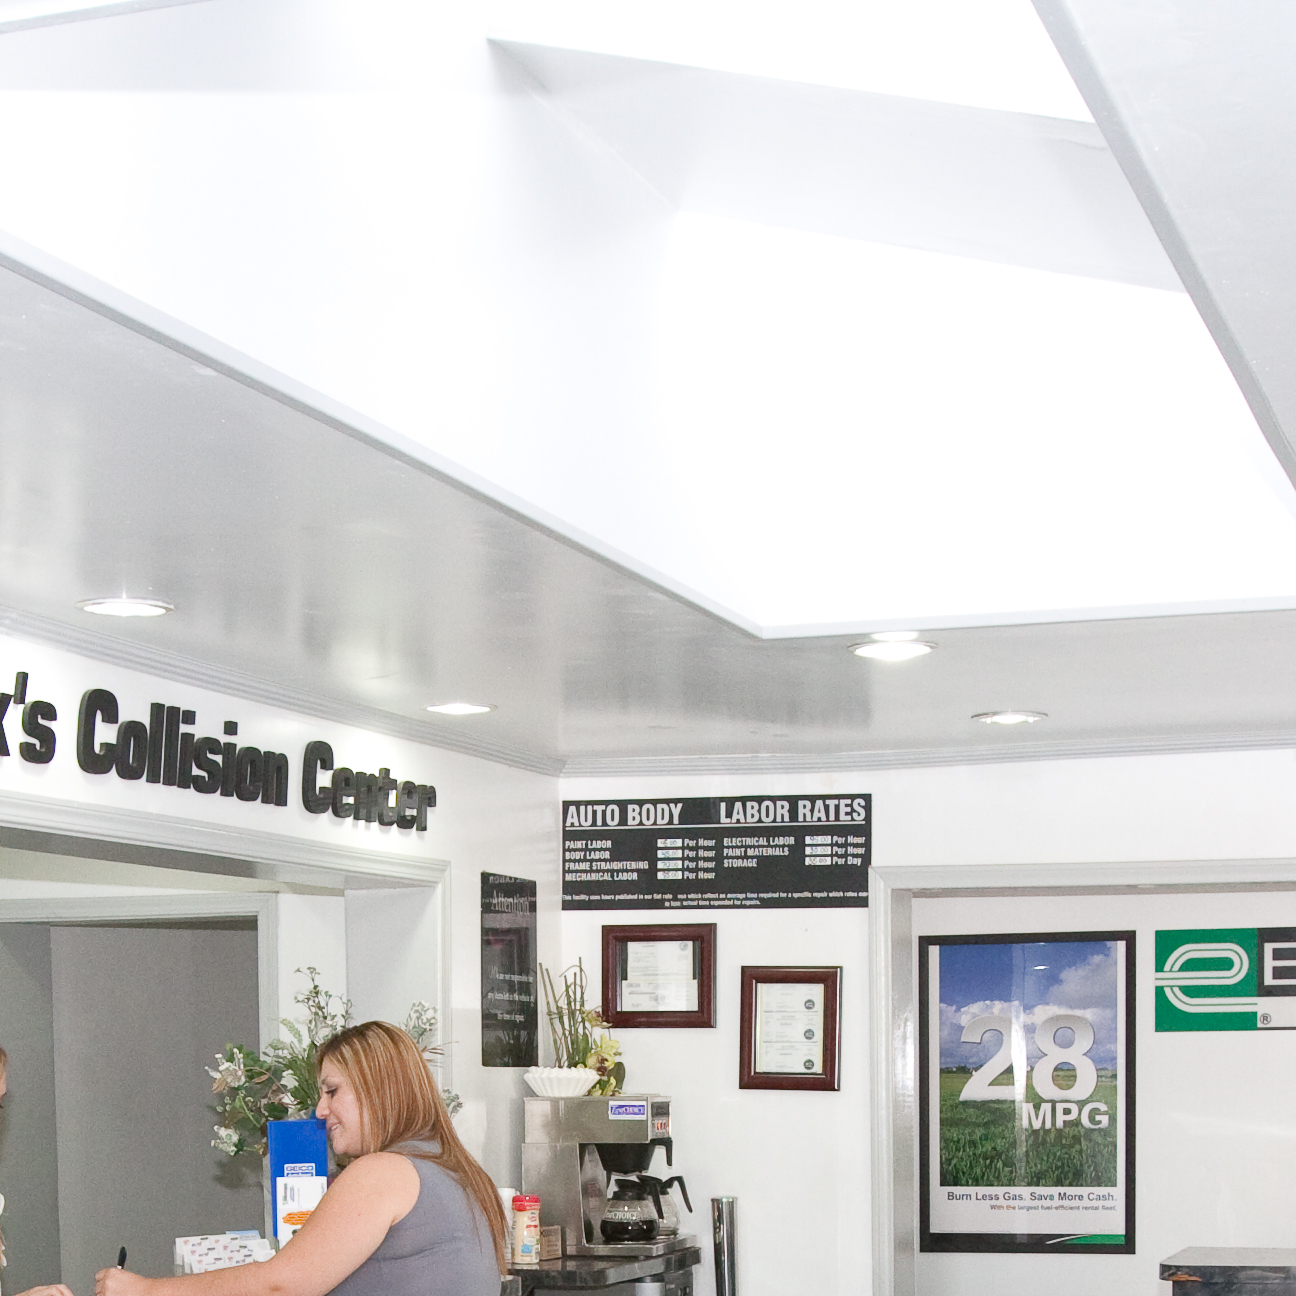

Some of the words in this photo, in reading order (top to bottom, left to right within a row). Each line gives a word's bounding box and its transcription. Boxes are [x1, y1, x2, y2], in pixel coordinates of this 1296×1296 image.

[76, 687, 289, 808] Collision
[301, 739, 438, 833] Center
[565, 803, 620, 827] AUTO
[627, 802, 683, 826] BODY
[719, 800, 790, 824] LABOR
[797, 798, 866, 822] RATES
[565, 840, 587, 849] PAINT
[588, 840, 612, 849] LABOR
[684, 838, 696, 847] Per
[698, 838, 716, 847] Hour
[723, 837, 768, 846] ELECTRICAL
[769, 836, 795, 845] LABOR
[833, 835, 846, 844] Per
[847, 835, 866, 844] Hour
[565, 851, 585, 860] BODY
[586, 850, 610, 859] LABOR
[684, 849, 696, 858] Per
[698, 849, 716, 858] Hour
[723, 848, 746, 857] PAINT
[747, 847, 789, 856] MATERIALS
[833, 846, 846, 855] Per
[847, 846, 866, 855] Hour
[565, 862, 591, 870] FRAME
[592, 861, 649, 870] STRAIGHTENING
[684, 860, 696, 869] Per
[698, 860, 716, 869] Hour
[723, 858, 758, 868] STORAGE
[833, 856, 846, 865] Per
[847, 856, 862, 867] Day
[565, 872, 612, 881] MECHANICAL
[613, 872, 638, 880] LABOR
[684, 871, 696, 880] Per
[698, 871, 716, 880] Hour
[491, 889, 530, 915] Attention
[959, 1013, 1099, 1101] 28
[1021, 1102, 1110, 1130] MPG
[947, 1192, 972, 1201] Burn
[975, 1192, 1000, 1201] Less
[1002, 1192, 1026, 1201] Gas.
[1029, 1192, 1055, 1201] Save
[1057, 1192, 1084, 1201] More
[1087, 1192, 1117, 1201] Cash.
[1017, 1204, 1040, 1212] largest
